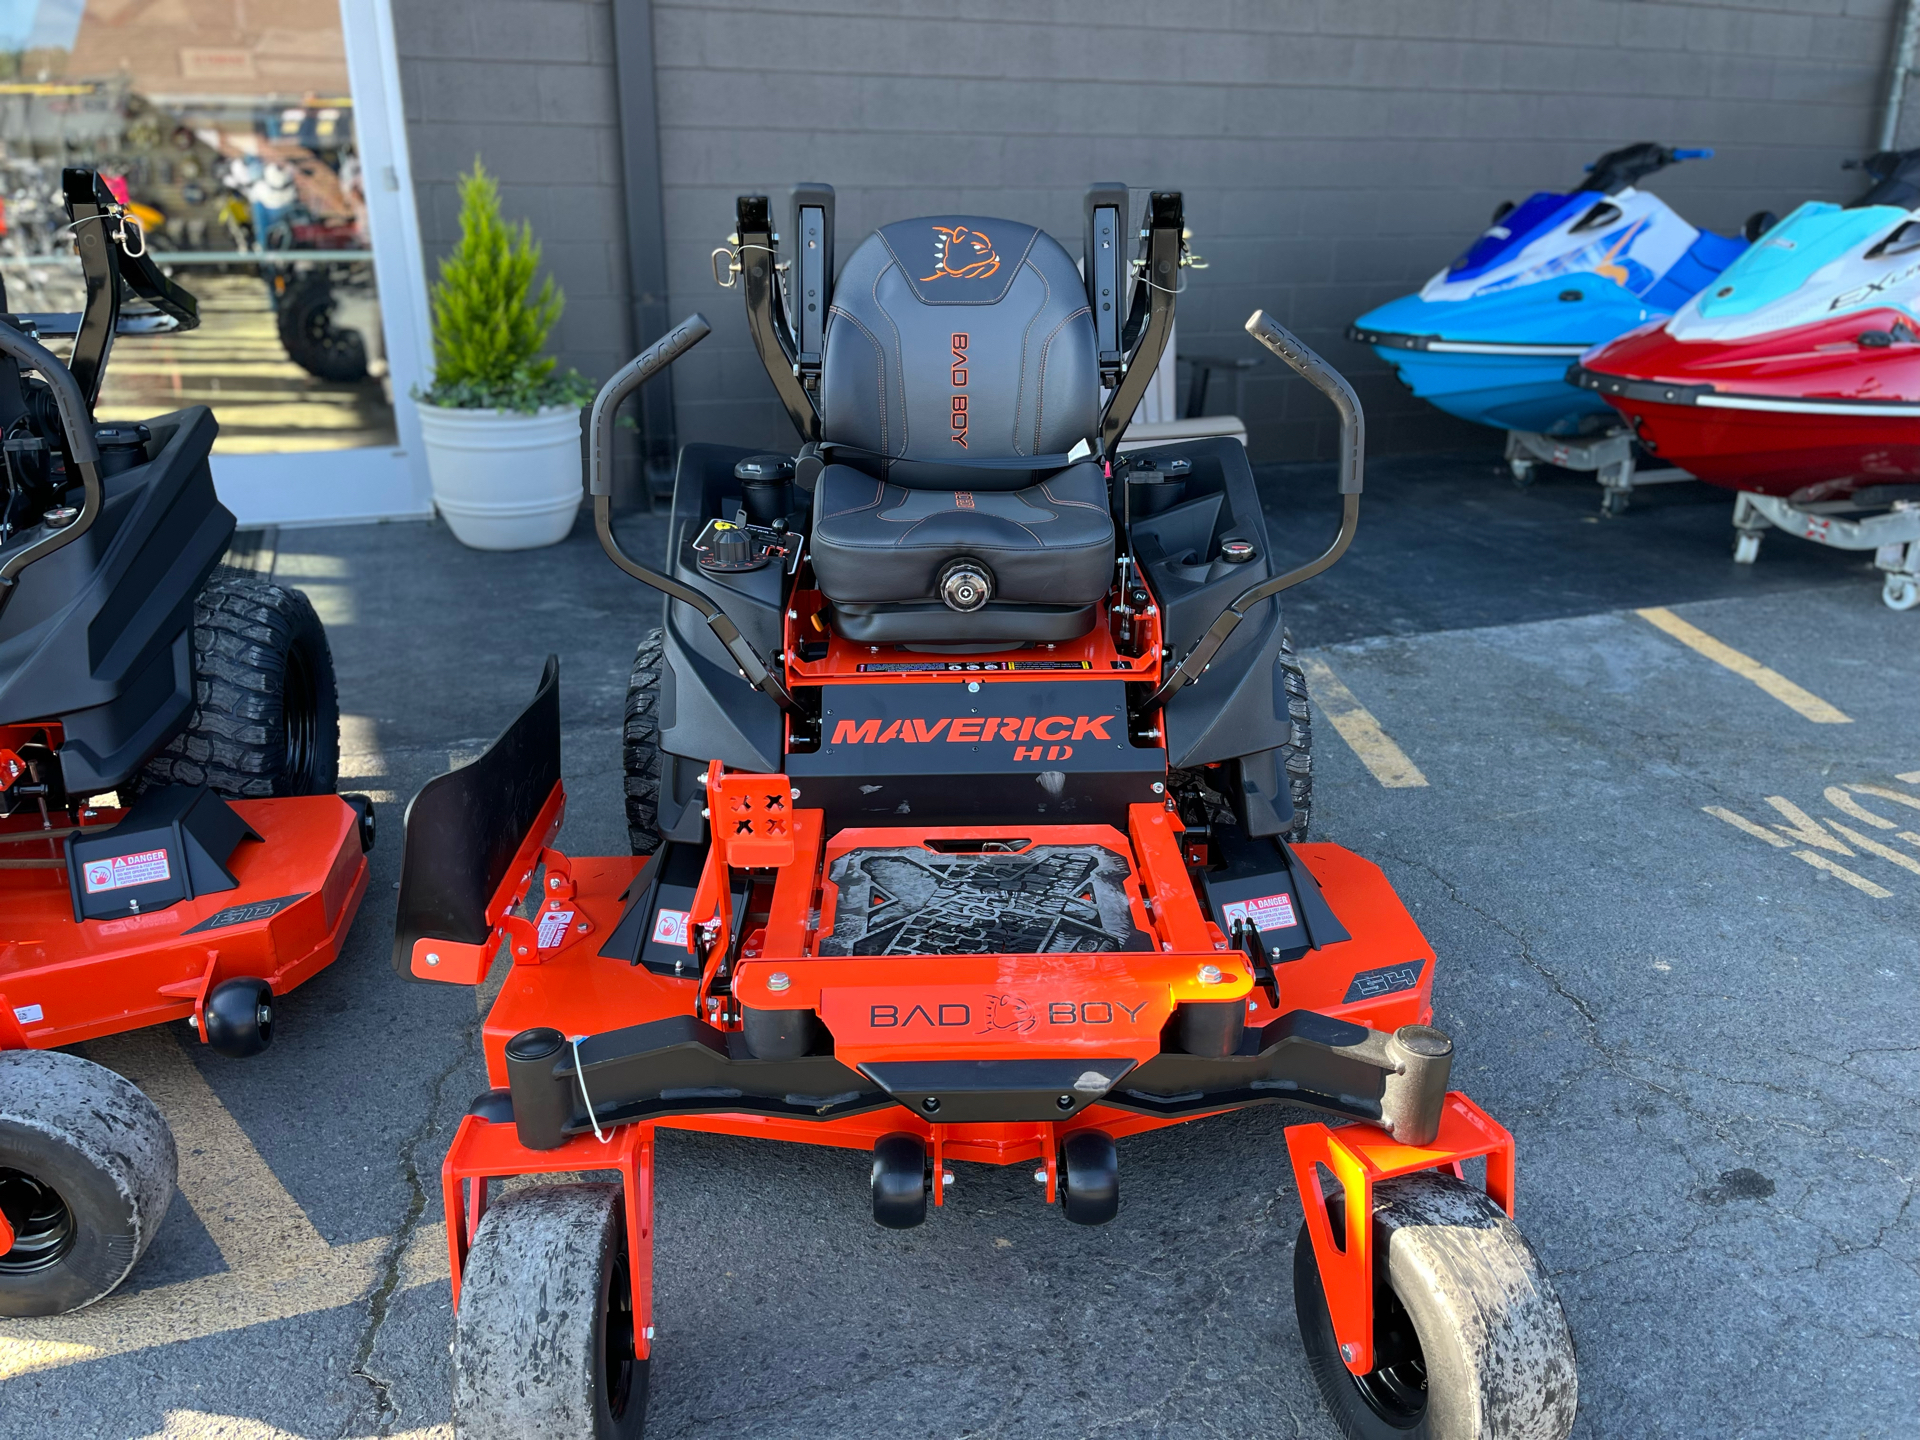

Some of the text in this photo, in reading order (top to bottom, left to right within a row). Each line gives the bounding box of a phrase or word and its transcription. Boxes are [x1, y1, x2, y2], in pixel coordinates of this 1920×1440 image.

[950, 332, 969, 450] BAD BOY
[831, 715, 1116, 744] MAVERICK
[1012, 744, 1074, 761] HD
[127, 851, 164, 865] DANGER
[1257, 896, 1288, 908] DANGER
[870, 1001, 1149, 1028] BAD BOY
